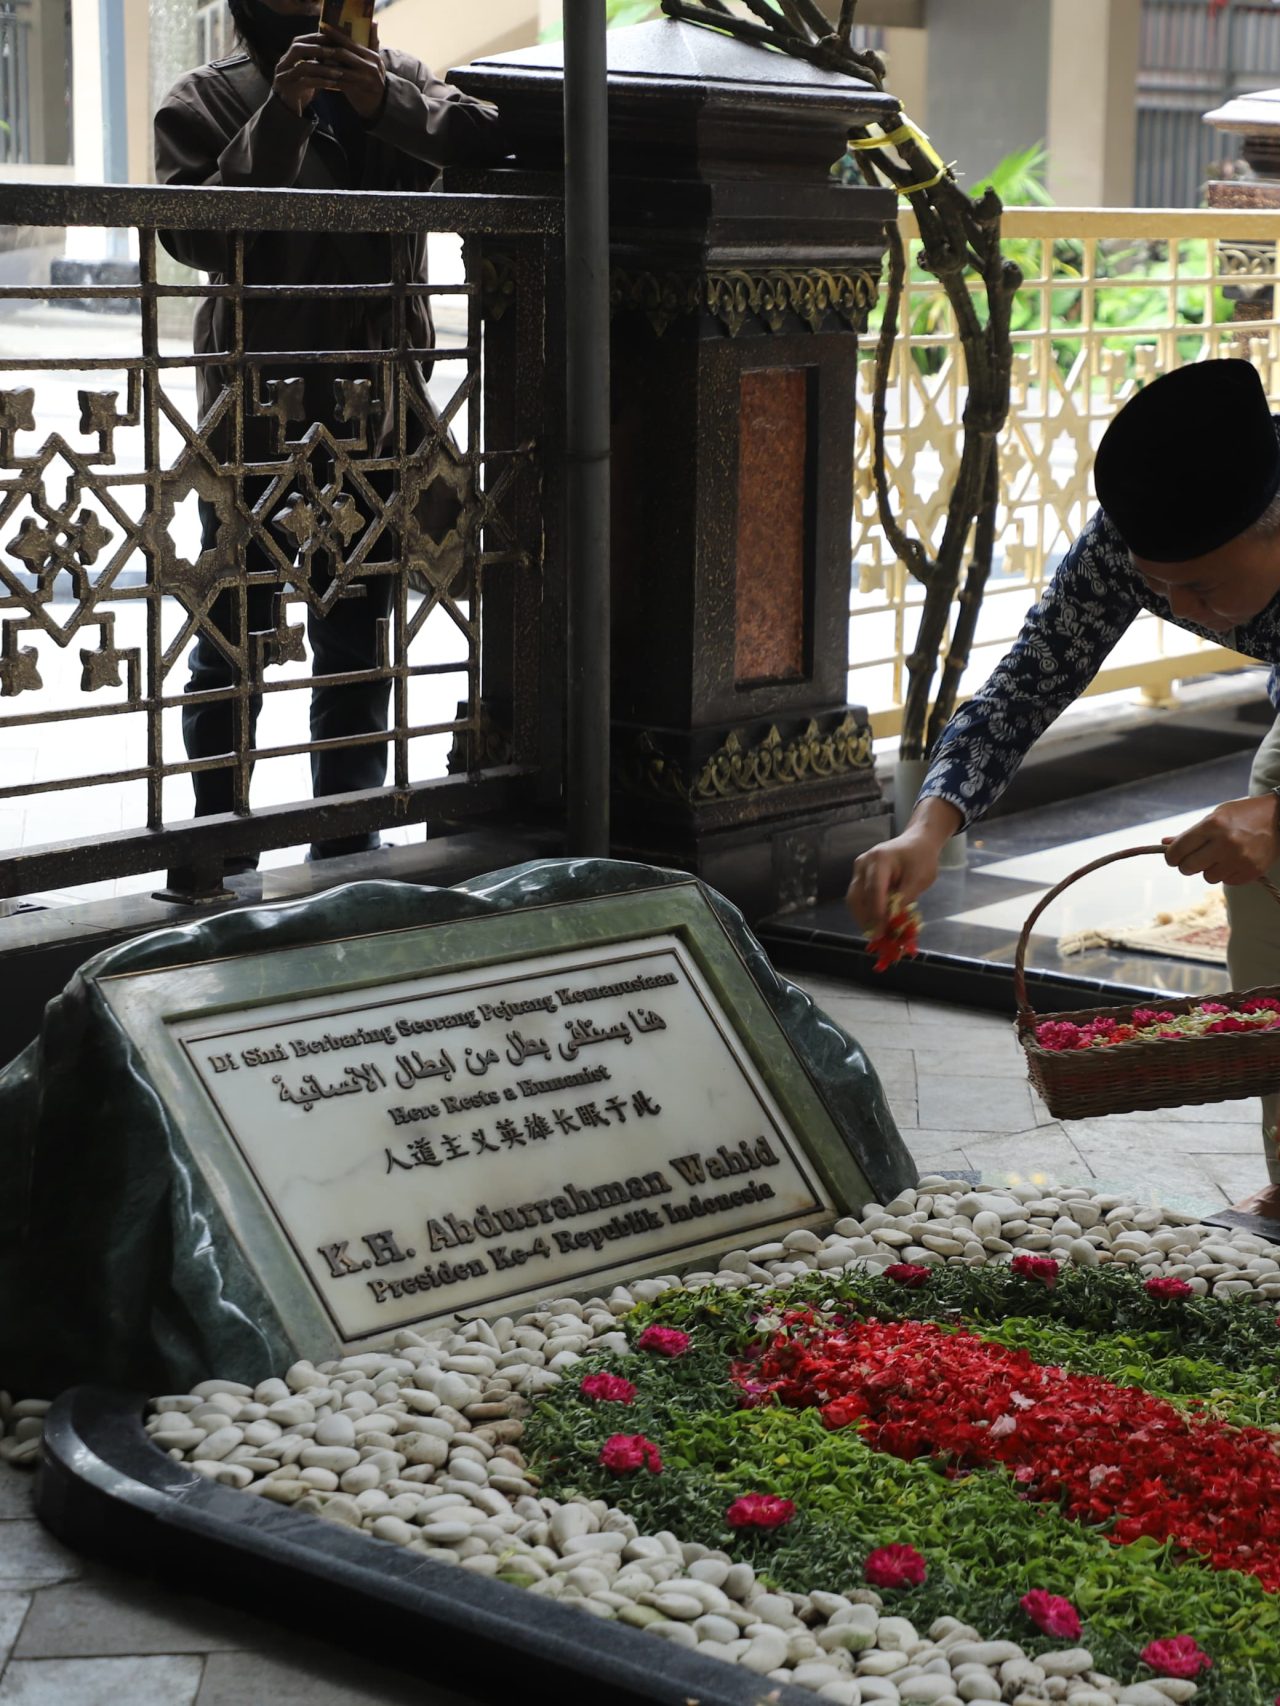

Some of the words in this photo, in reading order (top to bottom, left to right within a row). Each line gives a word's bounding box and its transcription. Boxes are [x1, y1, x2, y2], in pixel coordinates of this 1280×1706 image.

[208, 1052, 239, 1073] Di
[241, 1042, 289, 1067] Sini
[289, 1025, 398, 1057] Berbaring
[396, 1010, 481, 1037] Seorang
[478, 994, 558, 1021] Pejuang
[555, 972, 679, 1005] Kemanusiaan
[465, 1047, 500, 1076] من
[384, 1089, 662, 1174] 人道主义英雄长眠于此
[388, 1103, 441, 1126] Here
[441, 1089, 501, 1115] Rests
[503, 1086, 518, 1101] a
[517, 1064, 612, 1098] Humanist
[317, 1229, 417, 1278] K.H.
[427, 1170, 673, 1252] Abdurrahman
[668, 1135, 780, 1186] Wahid
[367, 1257, 489, 1303] Presiden
[487, 1237, 551, 1272] Ke-4
[552, 1208, 665, 1254] Republik
[661, 1180, 776, 1224] Indonesia
